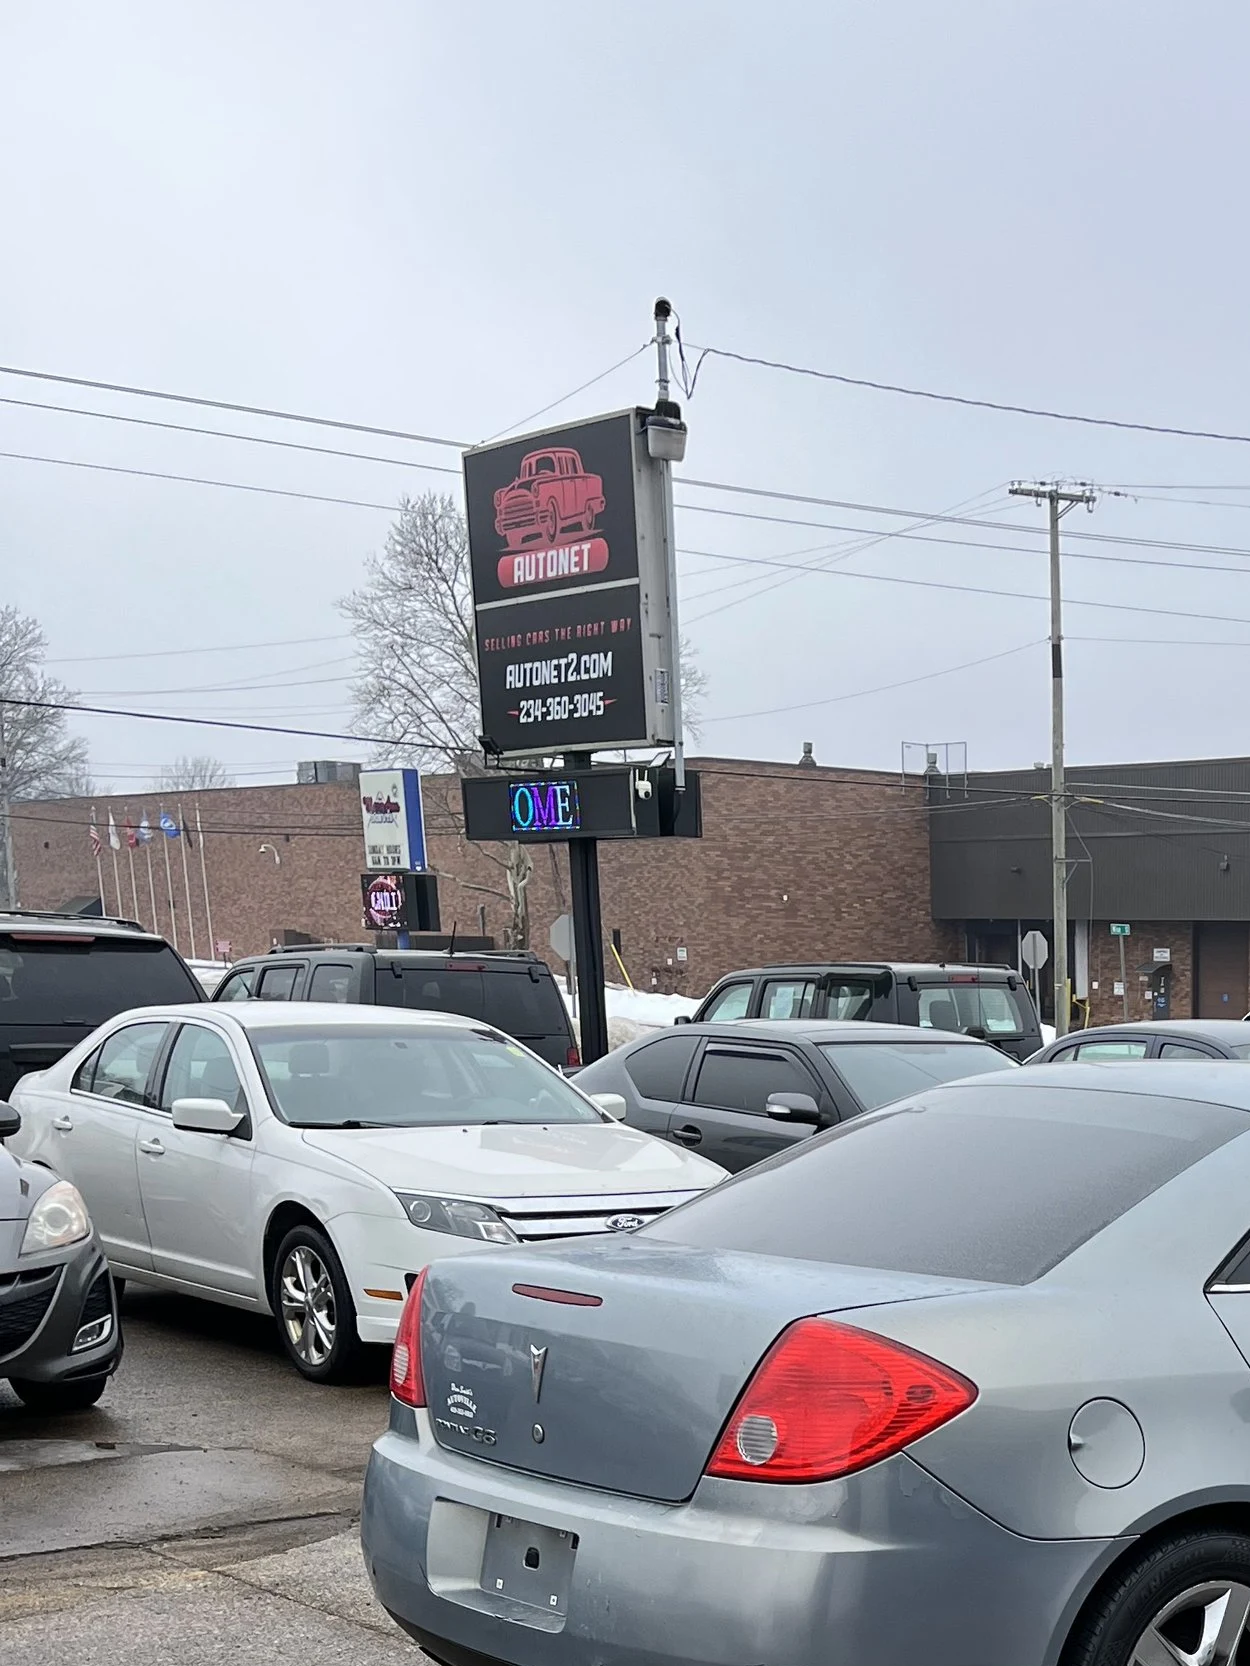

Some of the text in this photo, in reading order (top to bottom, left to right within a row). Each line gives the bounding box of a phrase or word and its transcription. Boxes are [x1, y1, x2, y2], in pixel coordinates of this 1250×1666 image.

[513, 542, 591, 584] AUTONET
[484, 617, 632, 652] SELLING CARS THE RIGHT WAY
[505, 651, 613, 690] AUTONET2.COM
[519, 691, 604, 724] 234-360-3045
[513, 785, 574, 827] OME
[472, 1425, 498, 1446] G6
